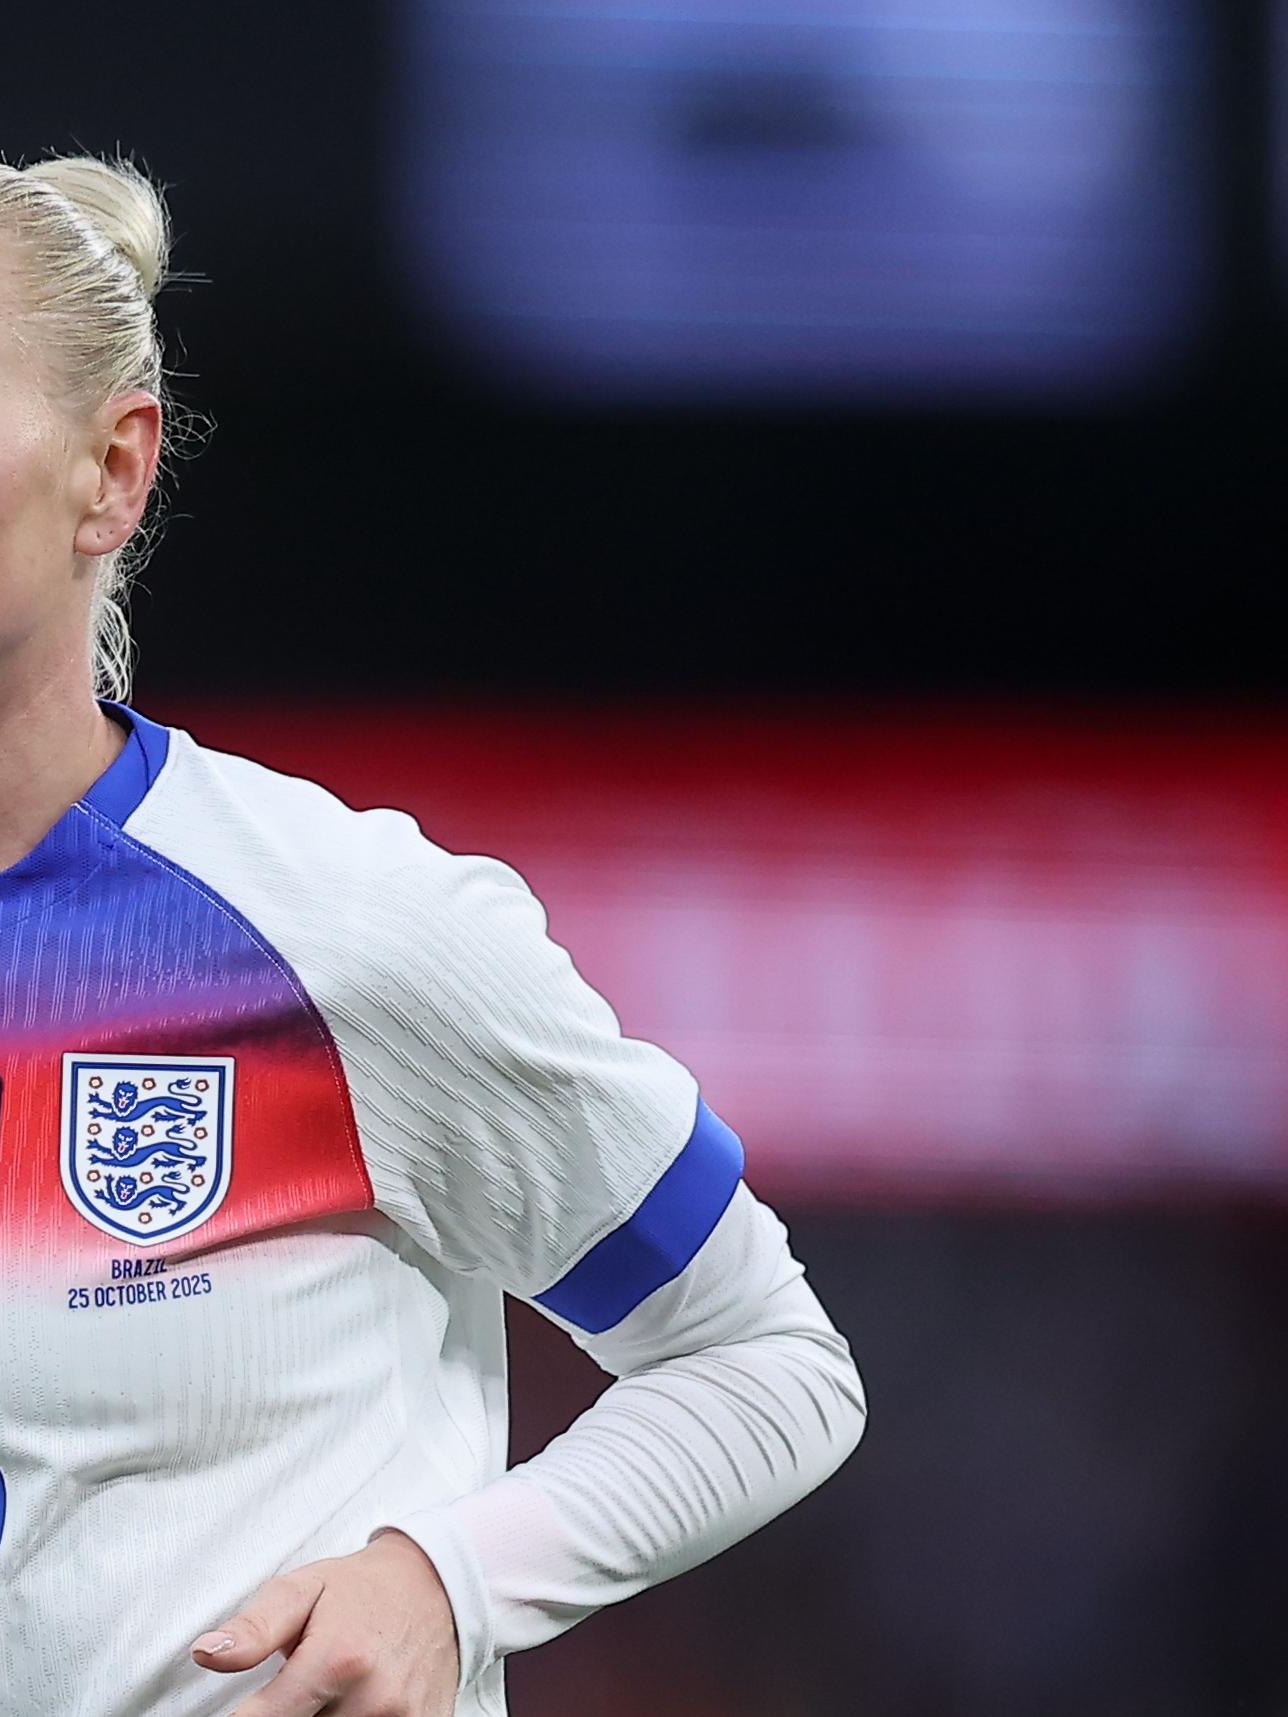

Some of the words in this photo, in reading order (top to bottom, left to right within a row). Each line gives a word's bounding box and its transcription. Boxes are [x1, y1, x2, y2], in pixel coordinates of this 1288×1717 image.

[111, 1258, 168, 1280] BRAZIL
[68, 1287, 90, 1309] 25
[94, 1281, 167, 1308] OCTOBER
[171, 1273, 212, 1299] 2025
